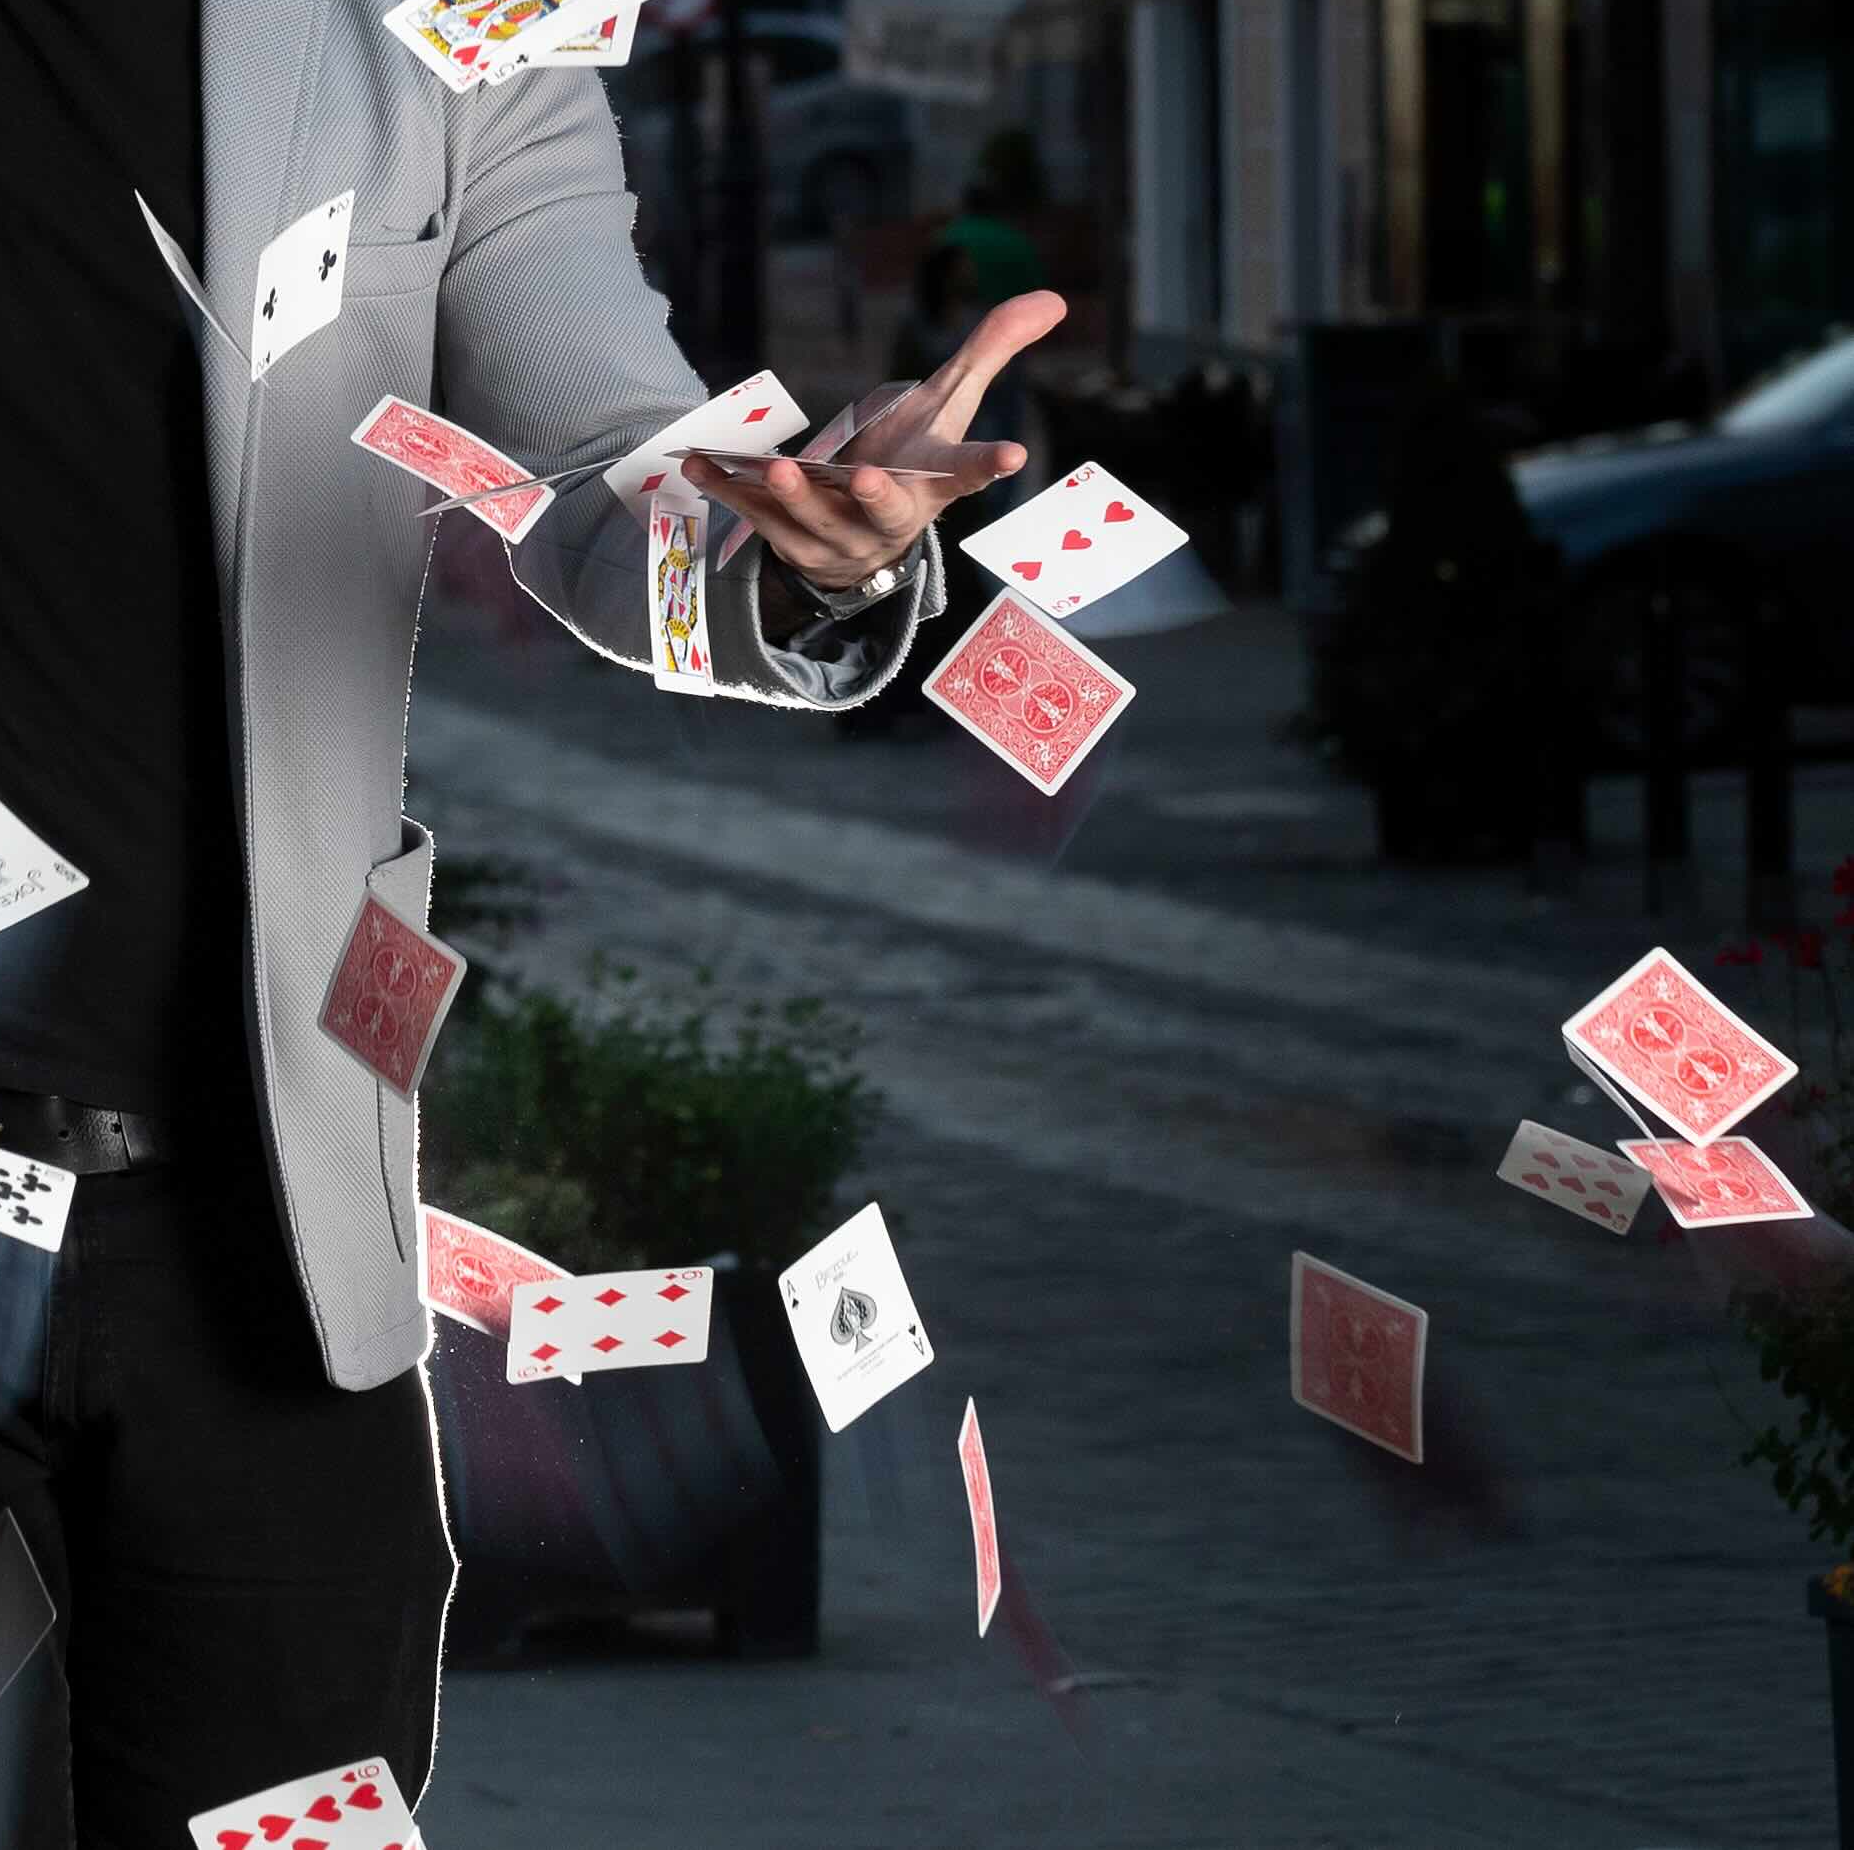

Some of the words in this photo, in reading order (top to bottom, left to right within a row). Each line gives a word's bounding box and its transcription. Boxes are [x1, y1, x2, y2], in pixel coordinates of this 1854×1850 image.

[742, 375, 764, 390] 2
[1075, 466, 1095, 482] 3
[1050, 599, 1072, 613] 3
[681, 1269, 704, 1280] 6
[786, 1278, 797, 1297] A
[912, 1336, 925, 1356] A
[516, 1366, 538, 1378] 6
[357, 1765, 380, 1779] 9
